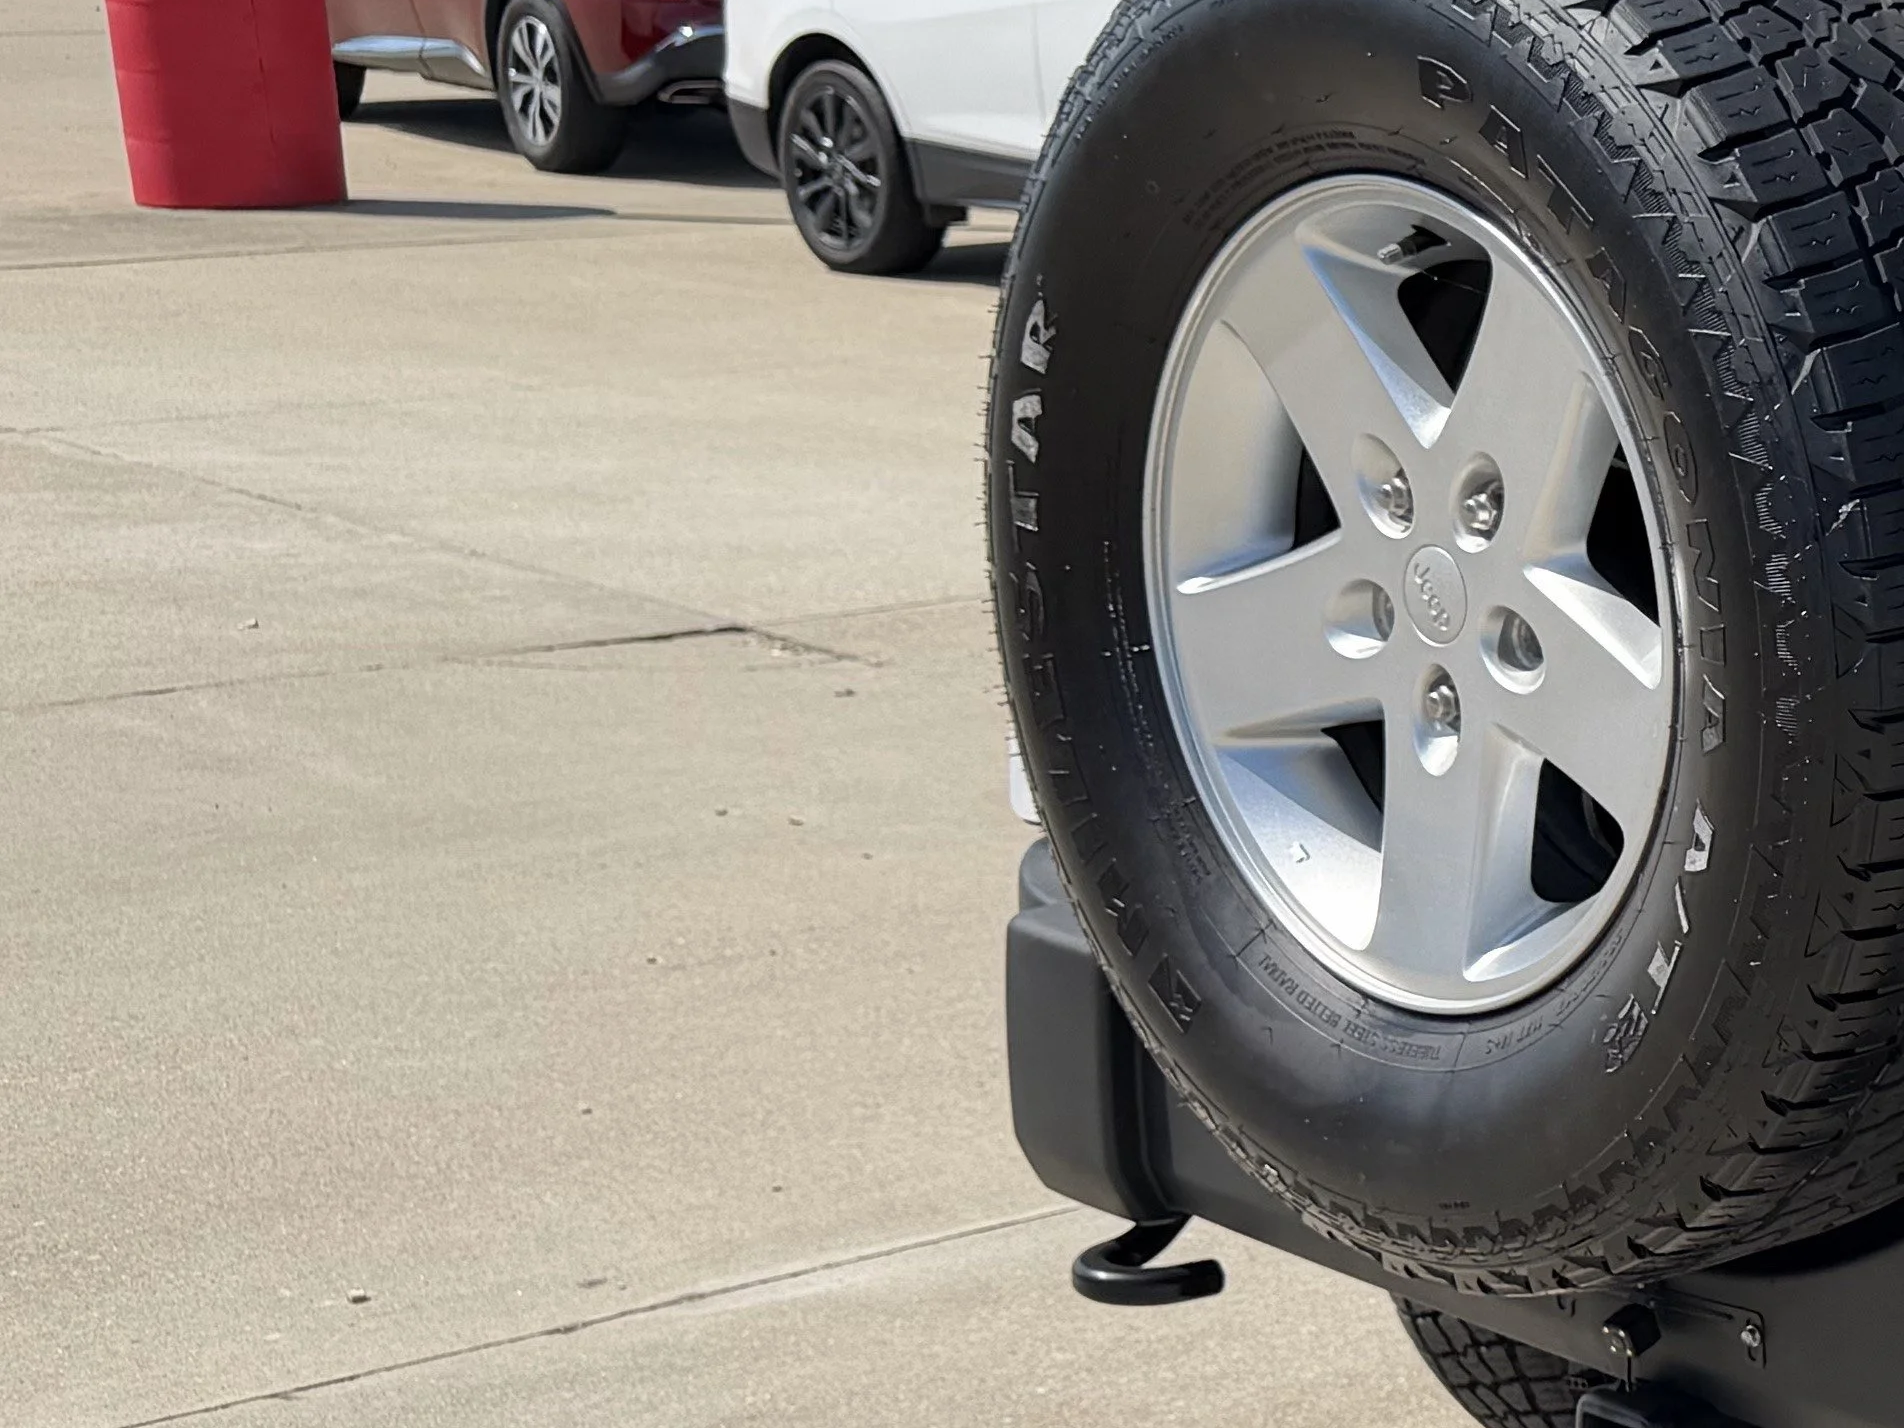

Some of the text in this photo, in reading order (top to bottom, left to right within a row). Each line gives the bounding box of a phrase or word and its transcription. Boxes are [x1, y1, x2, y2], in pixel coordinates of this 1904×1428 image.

[1416, 53, 1729, 755] PATAGONIA
[1009, 298, 1154, 958] MILESTAR
[1414, 561, 1451, 631] Jeep
[1257, 955, 1299, 996] RADIAL
[1297, 989, 1342, 1028] BELTED
